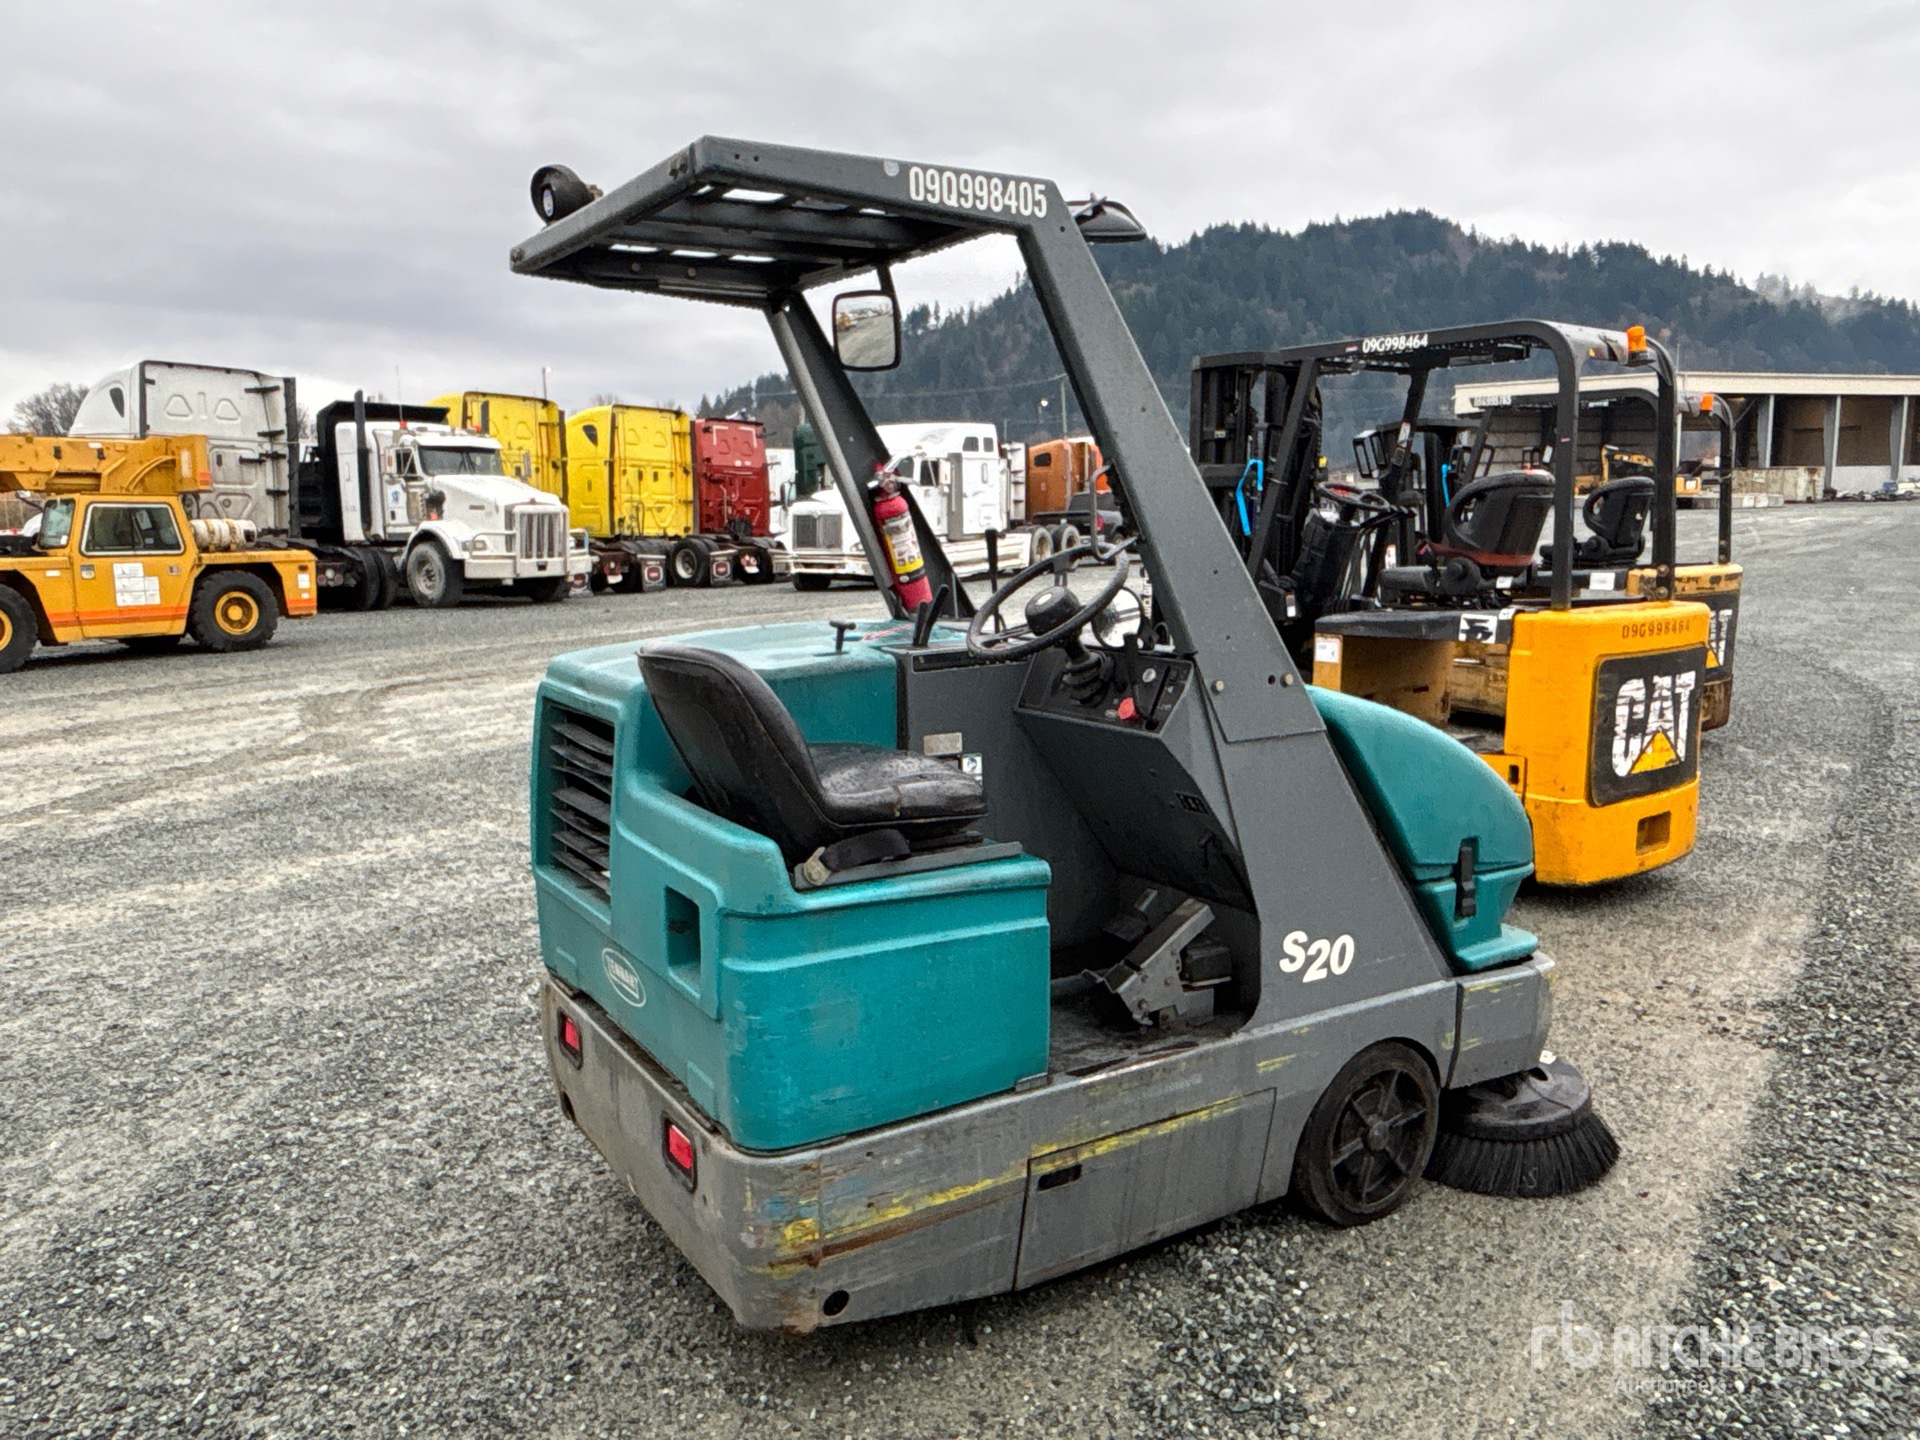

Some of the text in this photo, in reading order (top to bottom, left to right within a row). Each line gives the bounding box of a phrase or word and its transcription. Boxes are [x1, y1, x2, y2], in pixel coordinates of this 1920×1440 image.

[909, 166, 1047, 218] 09Q998405
[1362, 334, 1428, 353] 09G998464
[1621, 619, 1690, 639] 09G998464
[1612, 670, 1696, 777] CAT
[1279, 930, 1355, 983] S20
